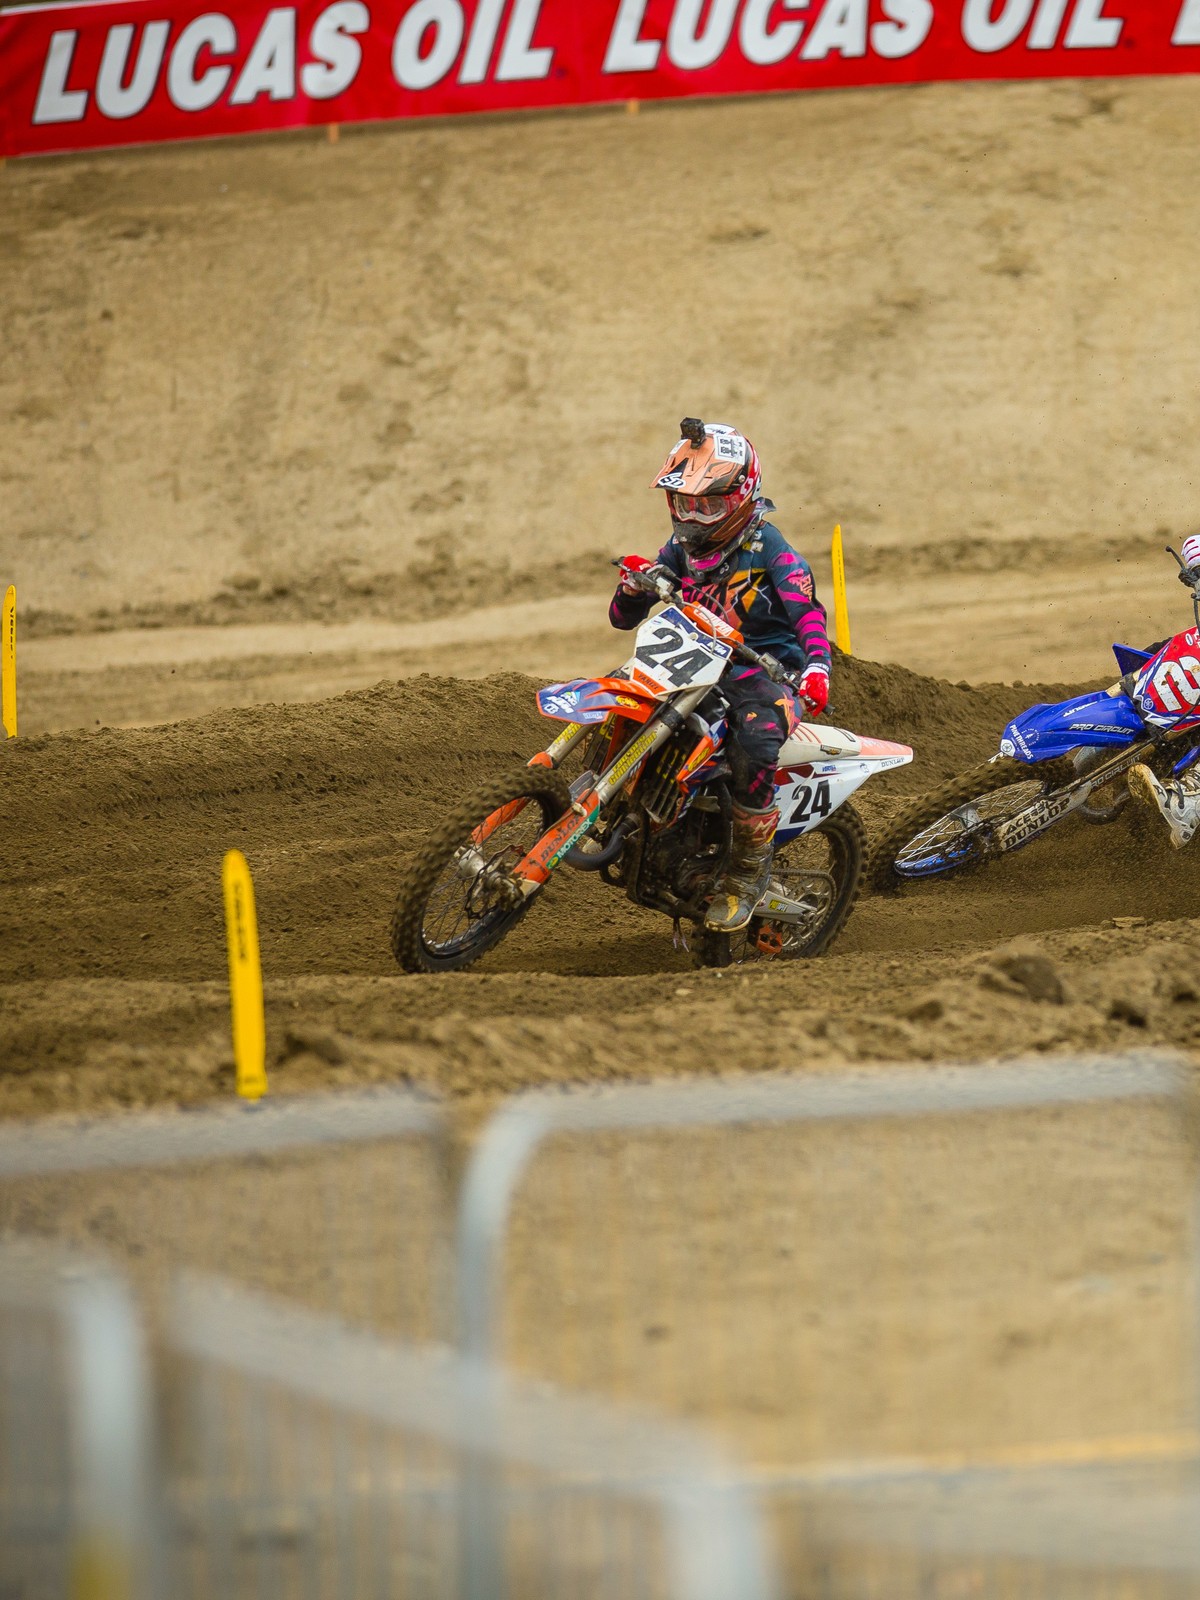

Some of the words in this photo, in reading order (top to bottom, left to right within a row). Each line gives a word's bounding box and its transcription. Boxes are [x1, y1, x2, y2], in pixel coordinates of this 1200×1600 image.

[32, 0, 369, 124] LUCAS
[392, 0, 556, 90] OIL
[602, 0, 934, 72] LUCAS
[961, 0, 1124, 53] OIL
[636, 627, 714, 687] 24
[1068, 723, 1092, 731] PRO
[1093, 724, 1135, 735] CIRCUIT
[789, 779, 832, 824] 24
[1004, 797, 1070, 850] DUNLOP
[556, 817, 593, 858] MOTOREX
